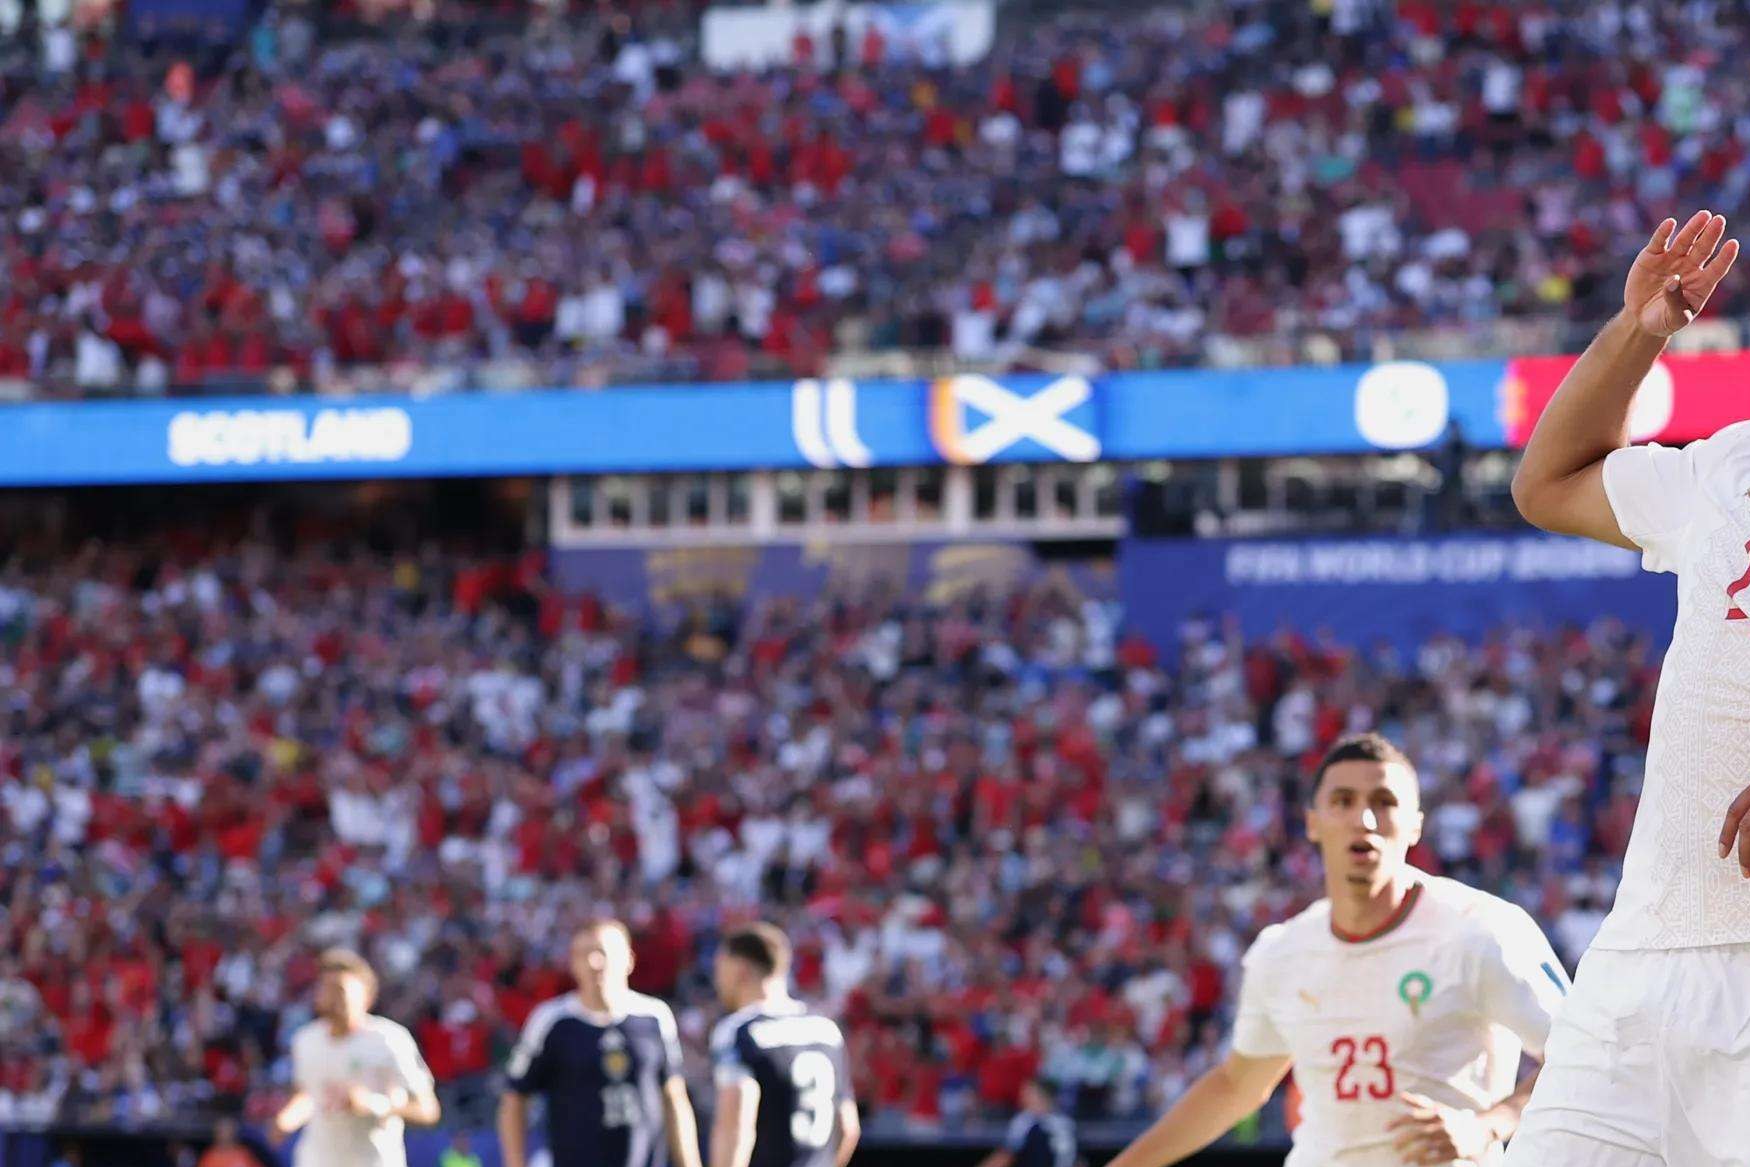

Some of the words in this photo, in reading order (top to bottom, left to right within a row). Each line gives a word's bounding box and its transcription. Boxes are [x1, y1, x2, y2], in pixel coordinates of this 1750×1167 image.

[169, 407, 412, 465] SCOTLAND
[1227, 541, 1300, 582] FIFA
[1310, 540, 1429, 581] WORLD
[1436, 540, 1504, 580] CUP
[1331, 1035, 1394, 1100] 23
[790, 1050, 836, 1148] 3
